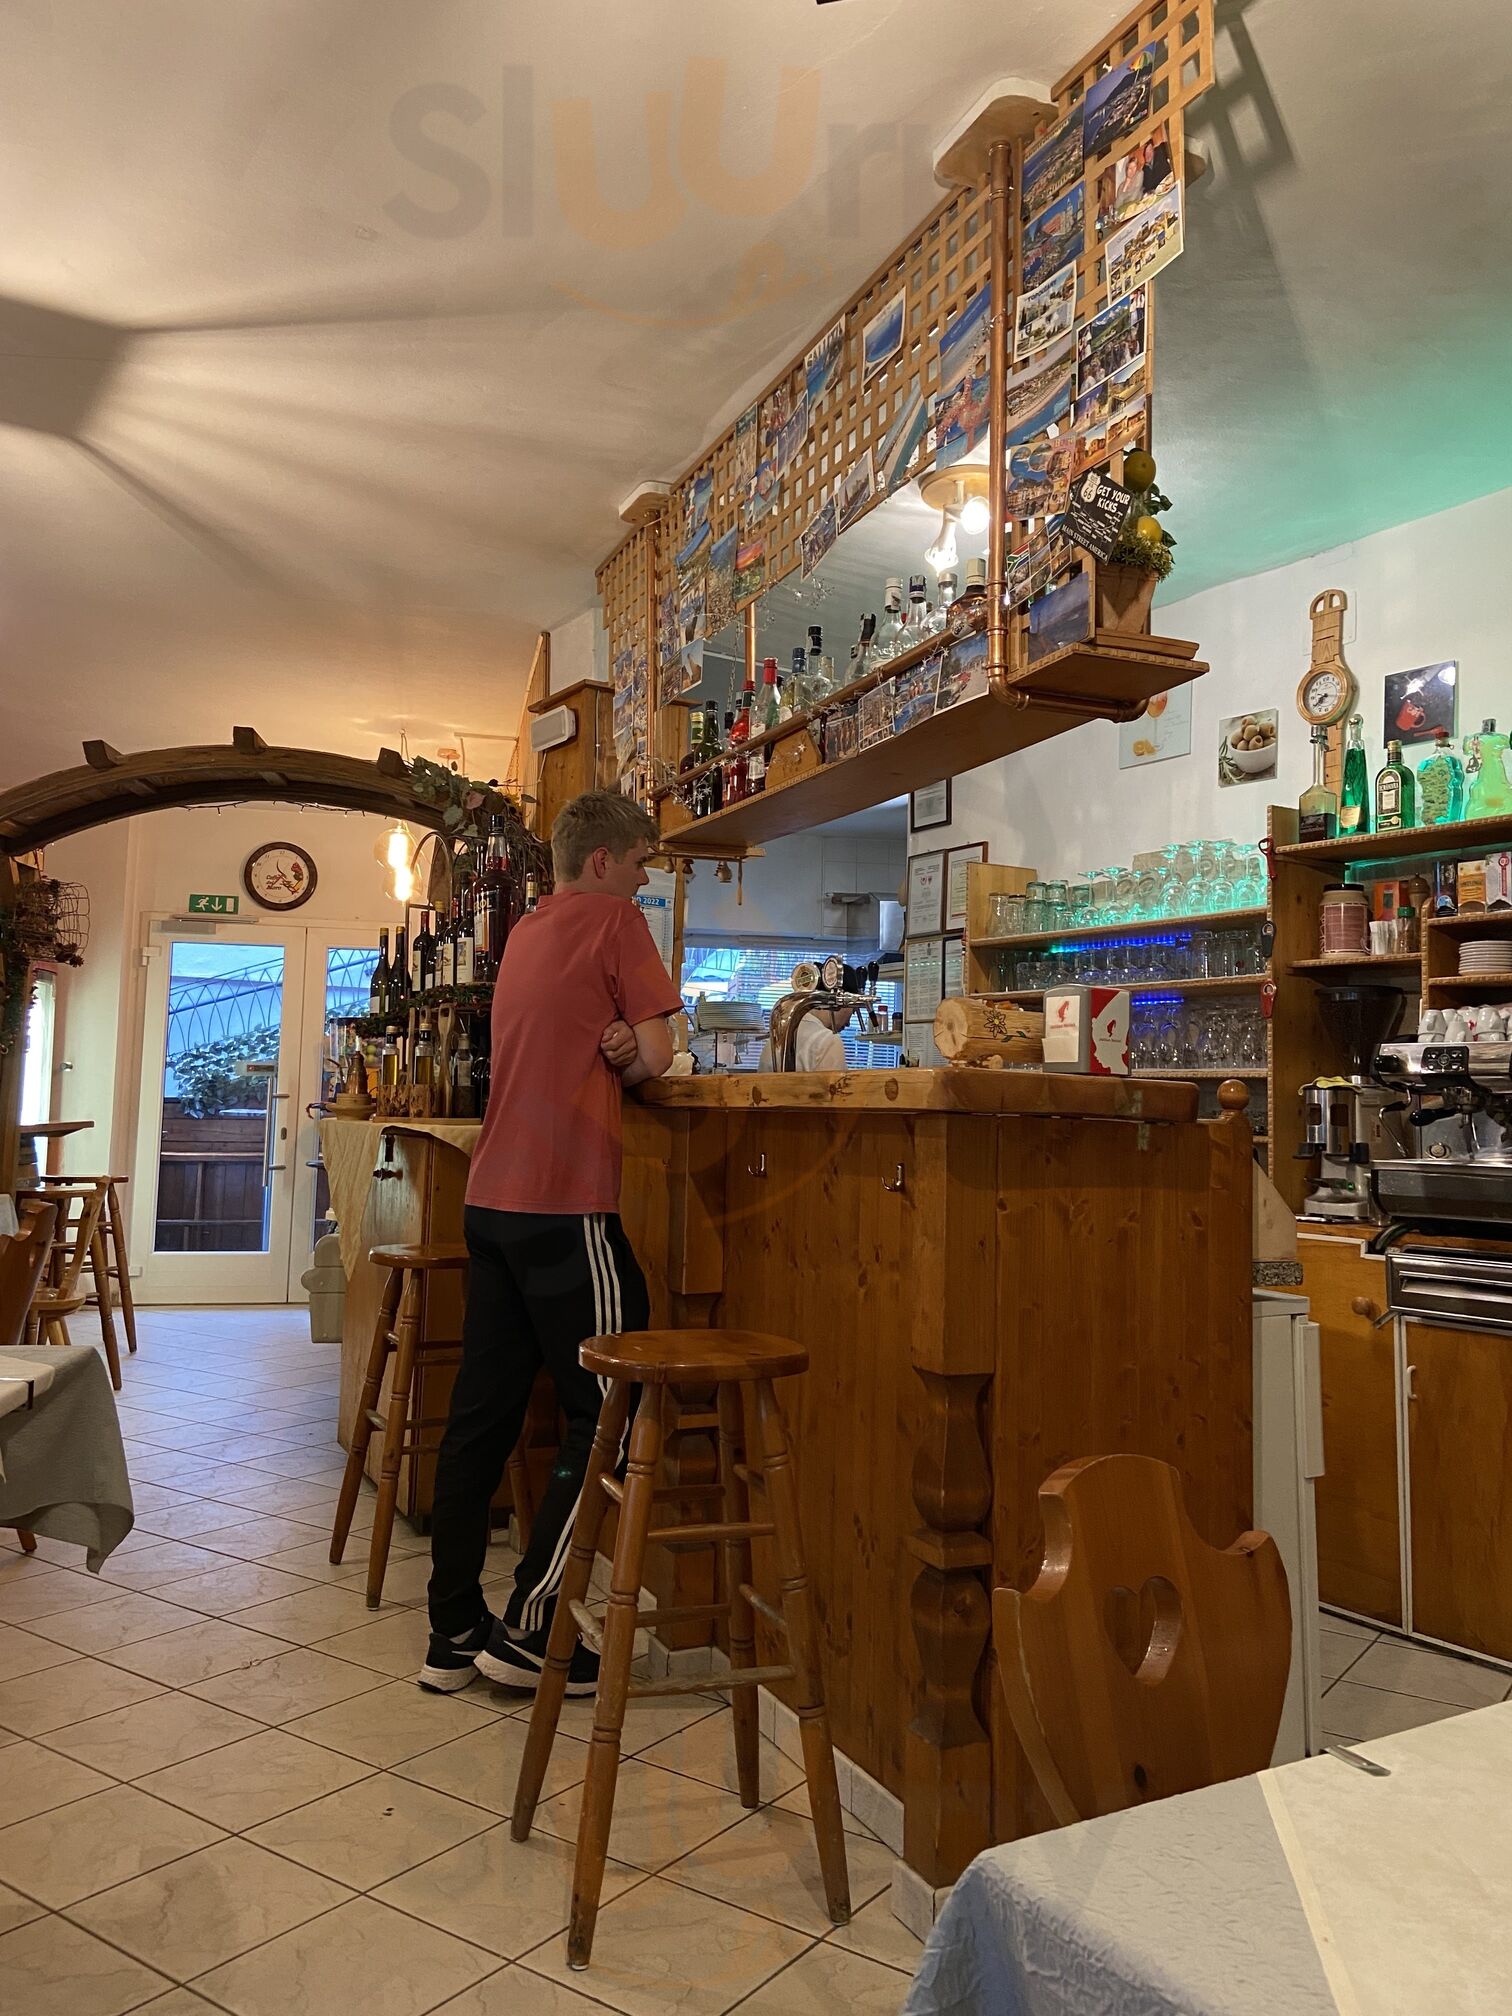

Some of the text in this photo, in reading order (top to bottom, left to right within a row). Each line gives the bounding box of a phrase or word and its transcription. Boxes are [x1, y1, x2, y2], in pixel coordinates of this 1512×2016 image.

[1083, 487, 1093, 500] 66
[1097, 485, 1131, 505] GET YOUR
[1097, 498, 1118, 512] KICKS
[1061, 524, 1108, 561] MAIN STREET AMERICA
[643, 897, 660, 905] 2022
